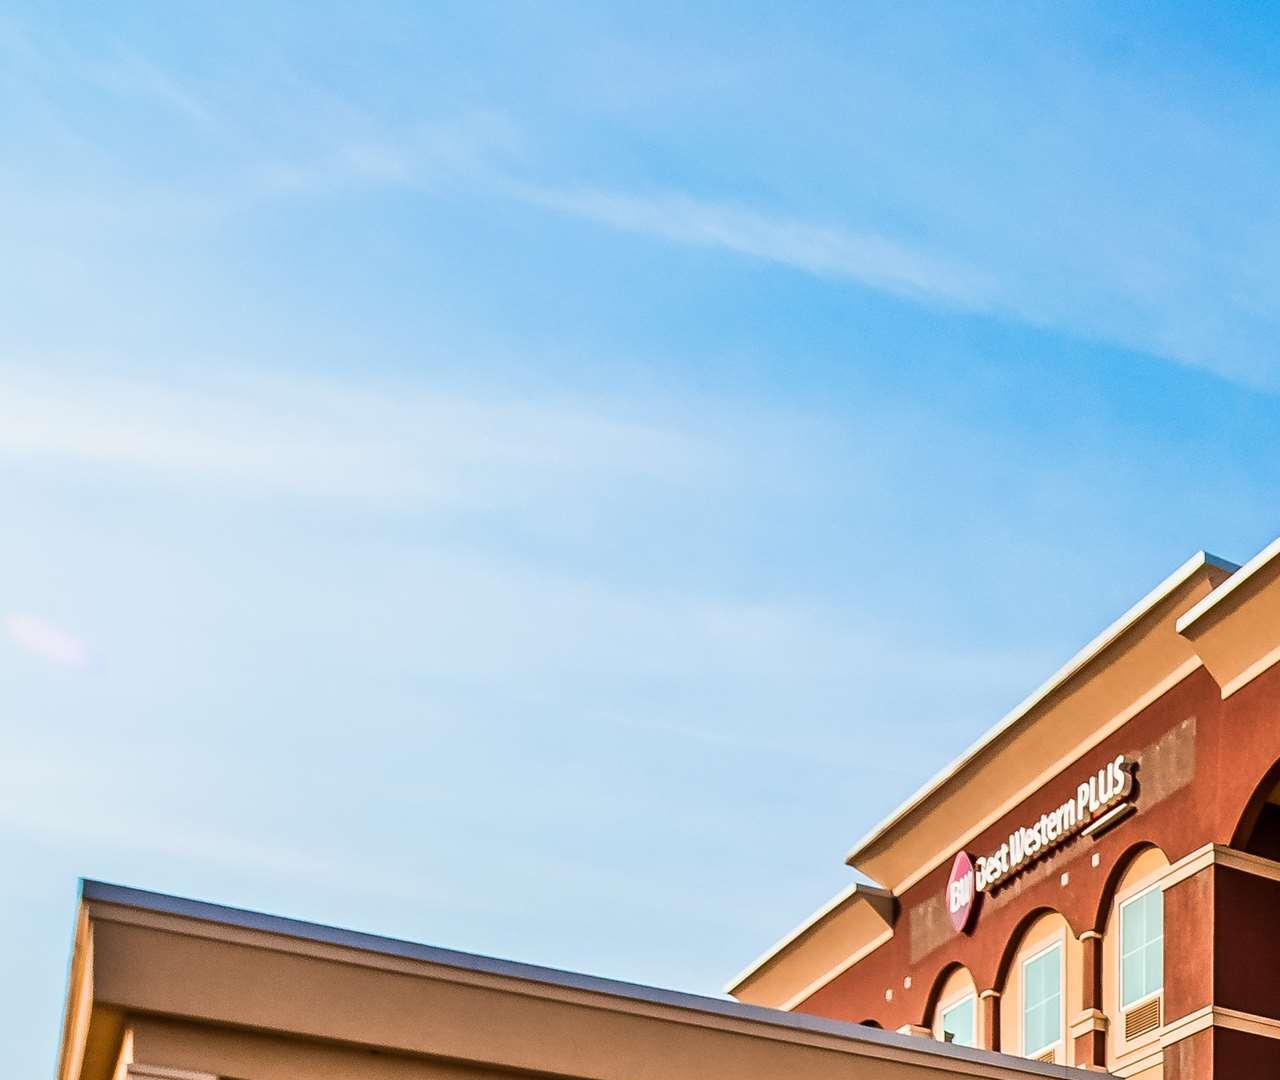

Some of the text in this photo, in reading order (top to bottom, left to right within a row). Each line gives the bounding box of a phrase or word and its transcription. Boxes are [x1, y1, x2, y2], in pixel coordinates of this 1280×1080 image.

[974, 754, 1125, 892] Best Western PLUS
